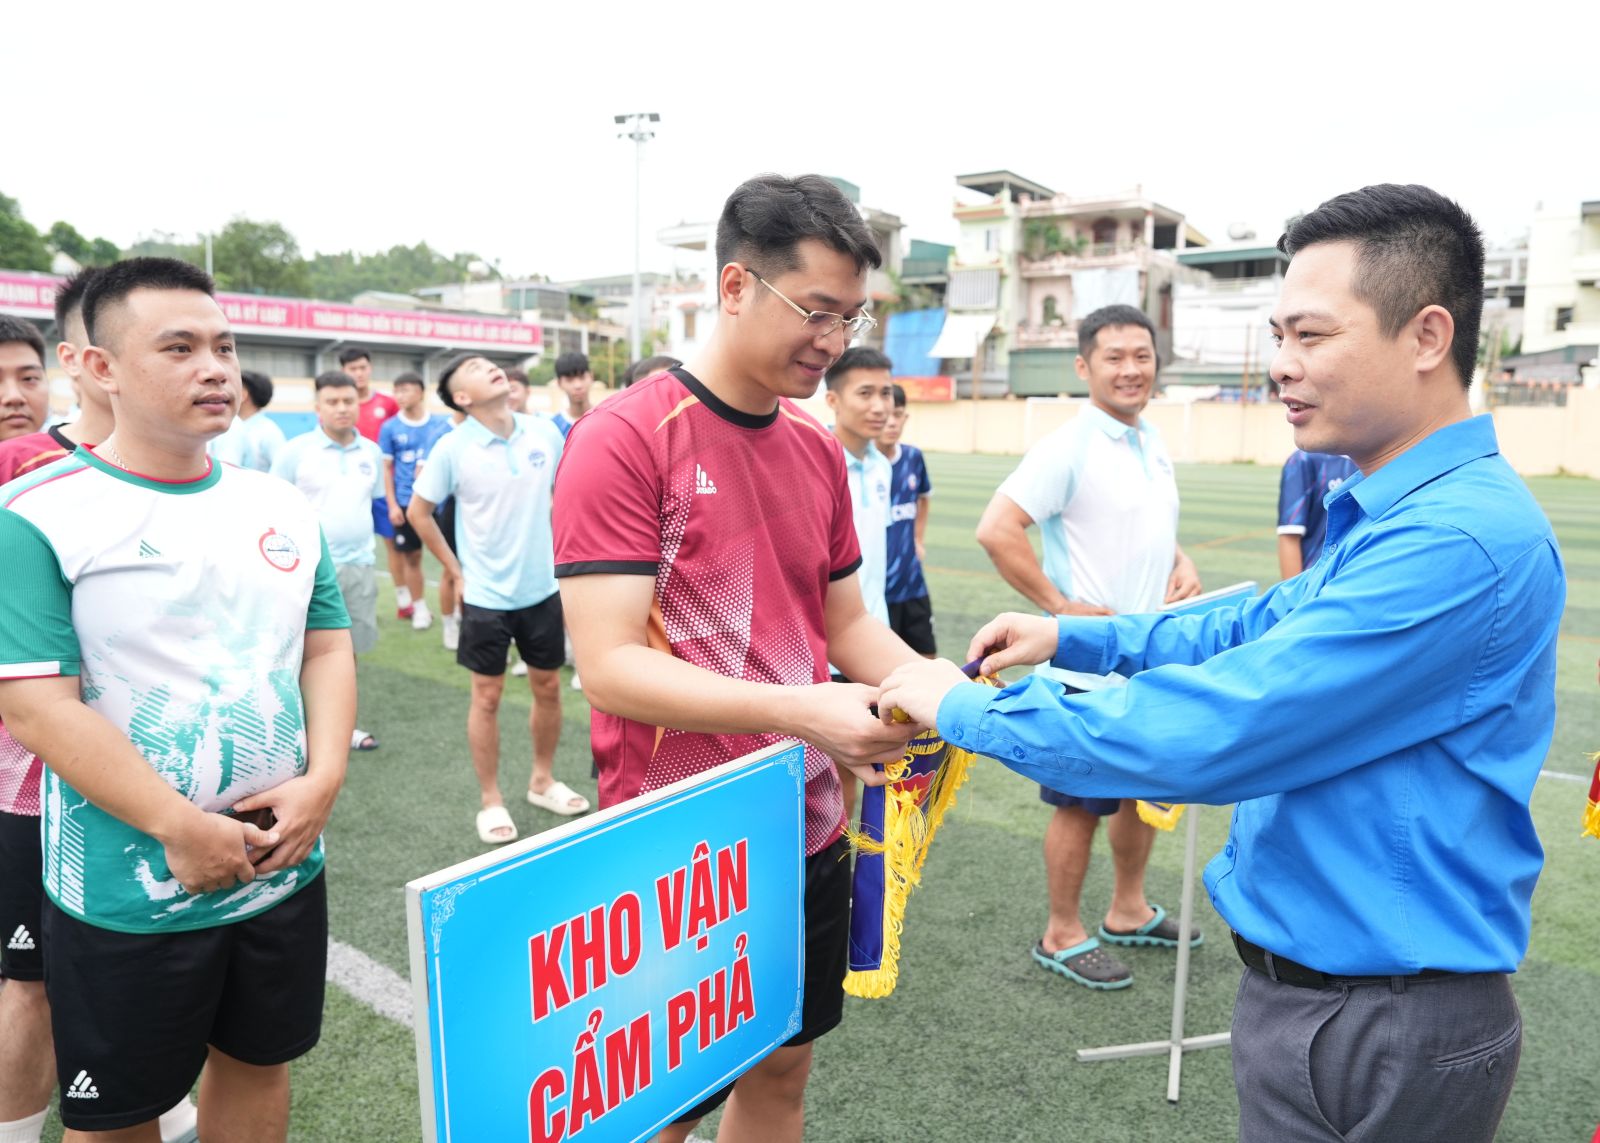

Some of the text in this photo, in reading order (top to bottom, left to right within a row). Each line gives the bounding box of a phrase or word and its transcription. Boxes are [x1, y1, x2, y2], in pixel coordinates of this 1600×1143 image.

[529, 837, 748, 1023] KHO VẬN
[66, 1091, 100, 1099] JOTADO
[528, 931, 756, 1143] CẨM PHẢ
